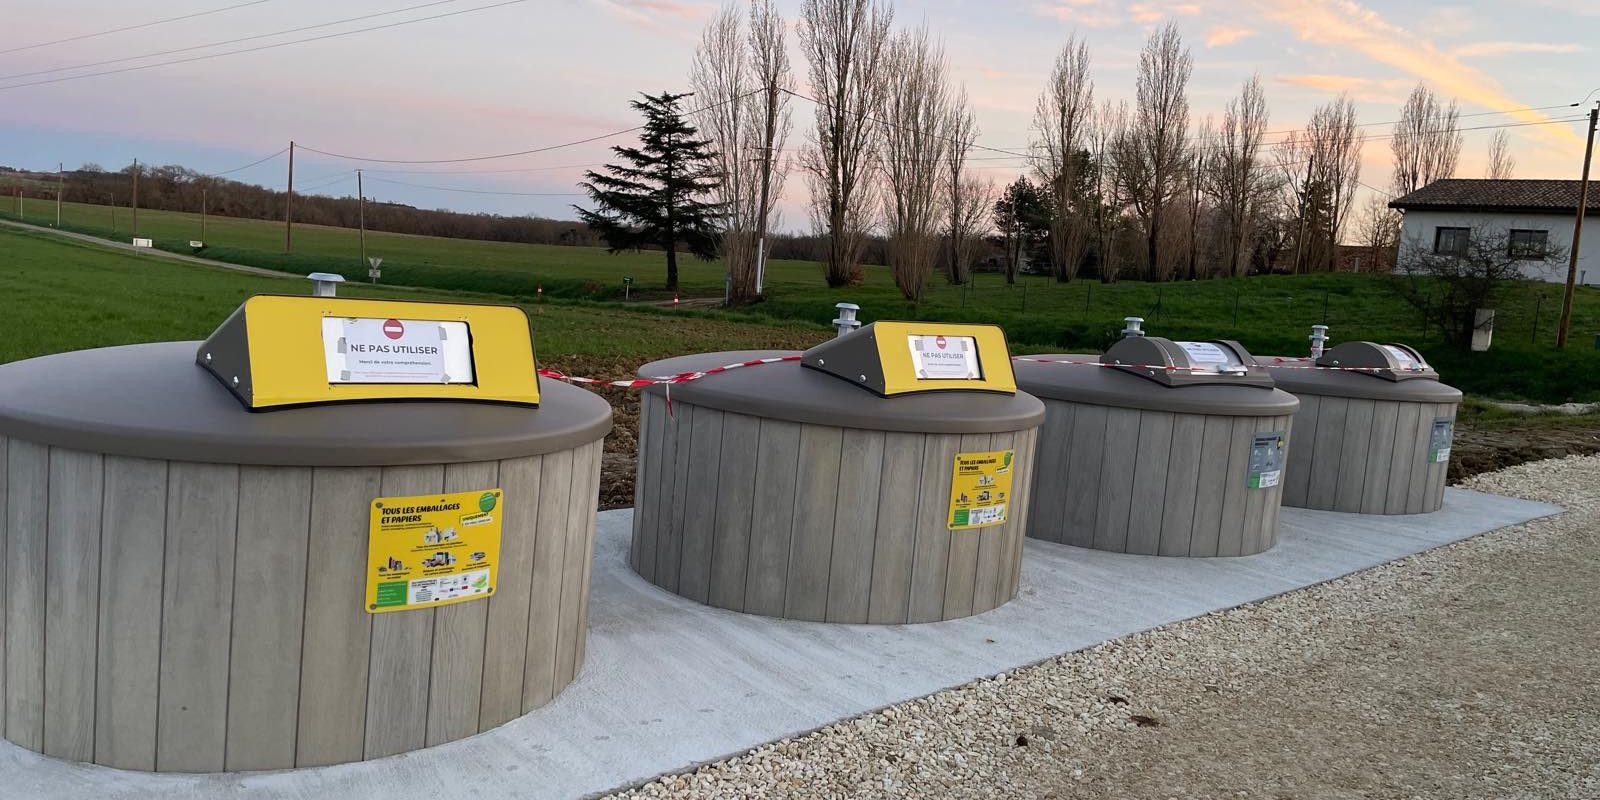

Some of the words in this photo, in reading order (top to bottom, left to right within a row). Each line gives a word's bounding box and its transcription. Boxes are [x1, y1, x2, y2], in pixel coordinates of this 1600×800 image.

[351, 344, 365, 352] NE
[369, 344, 390, 353] PAS
[393, 346, 438, 355] UTILISER
[382, 507, 401, 515] TOUS
[402, 506, 415, 514] LES
[416, 503, 461, 513] EMBALLAGES
[381, 516, 391, 524] ET
[391, 515, 422, 523] PAPIERS
